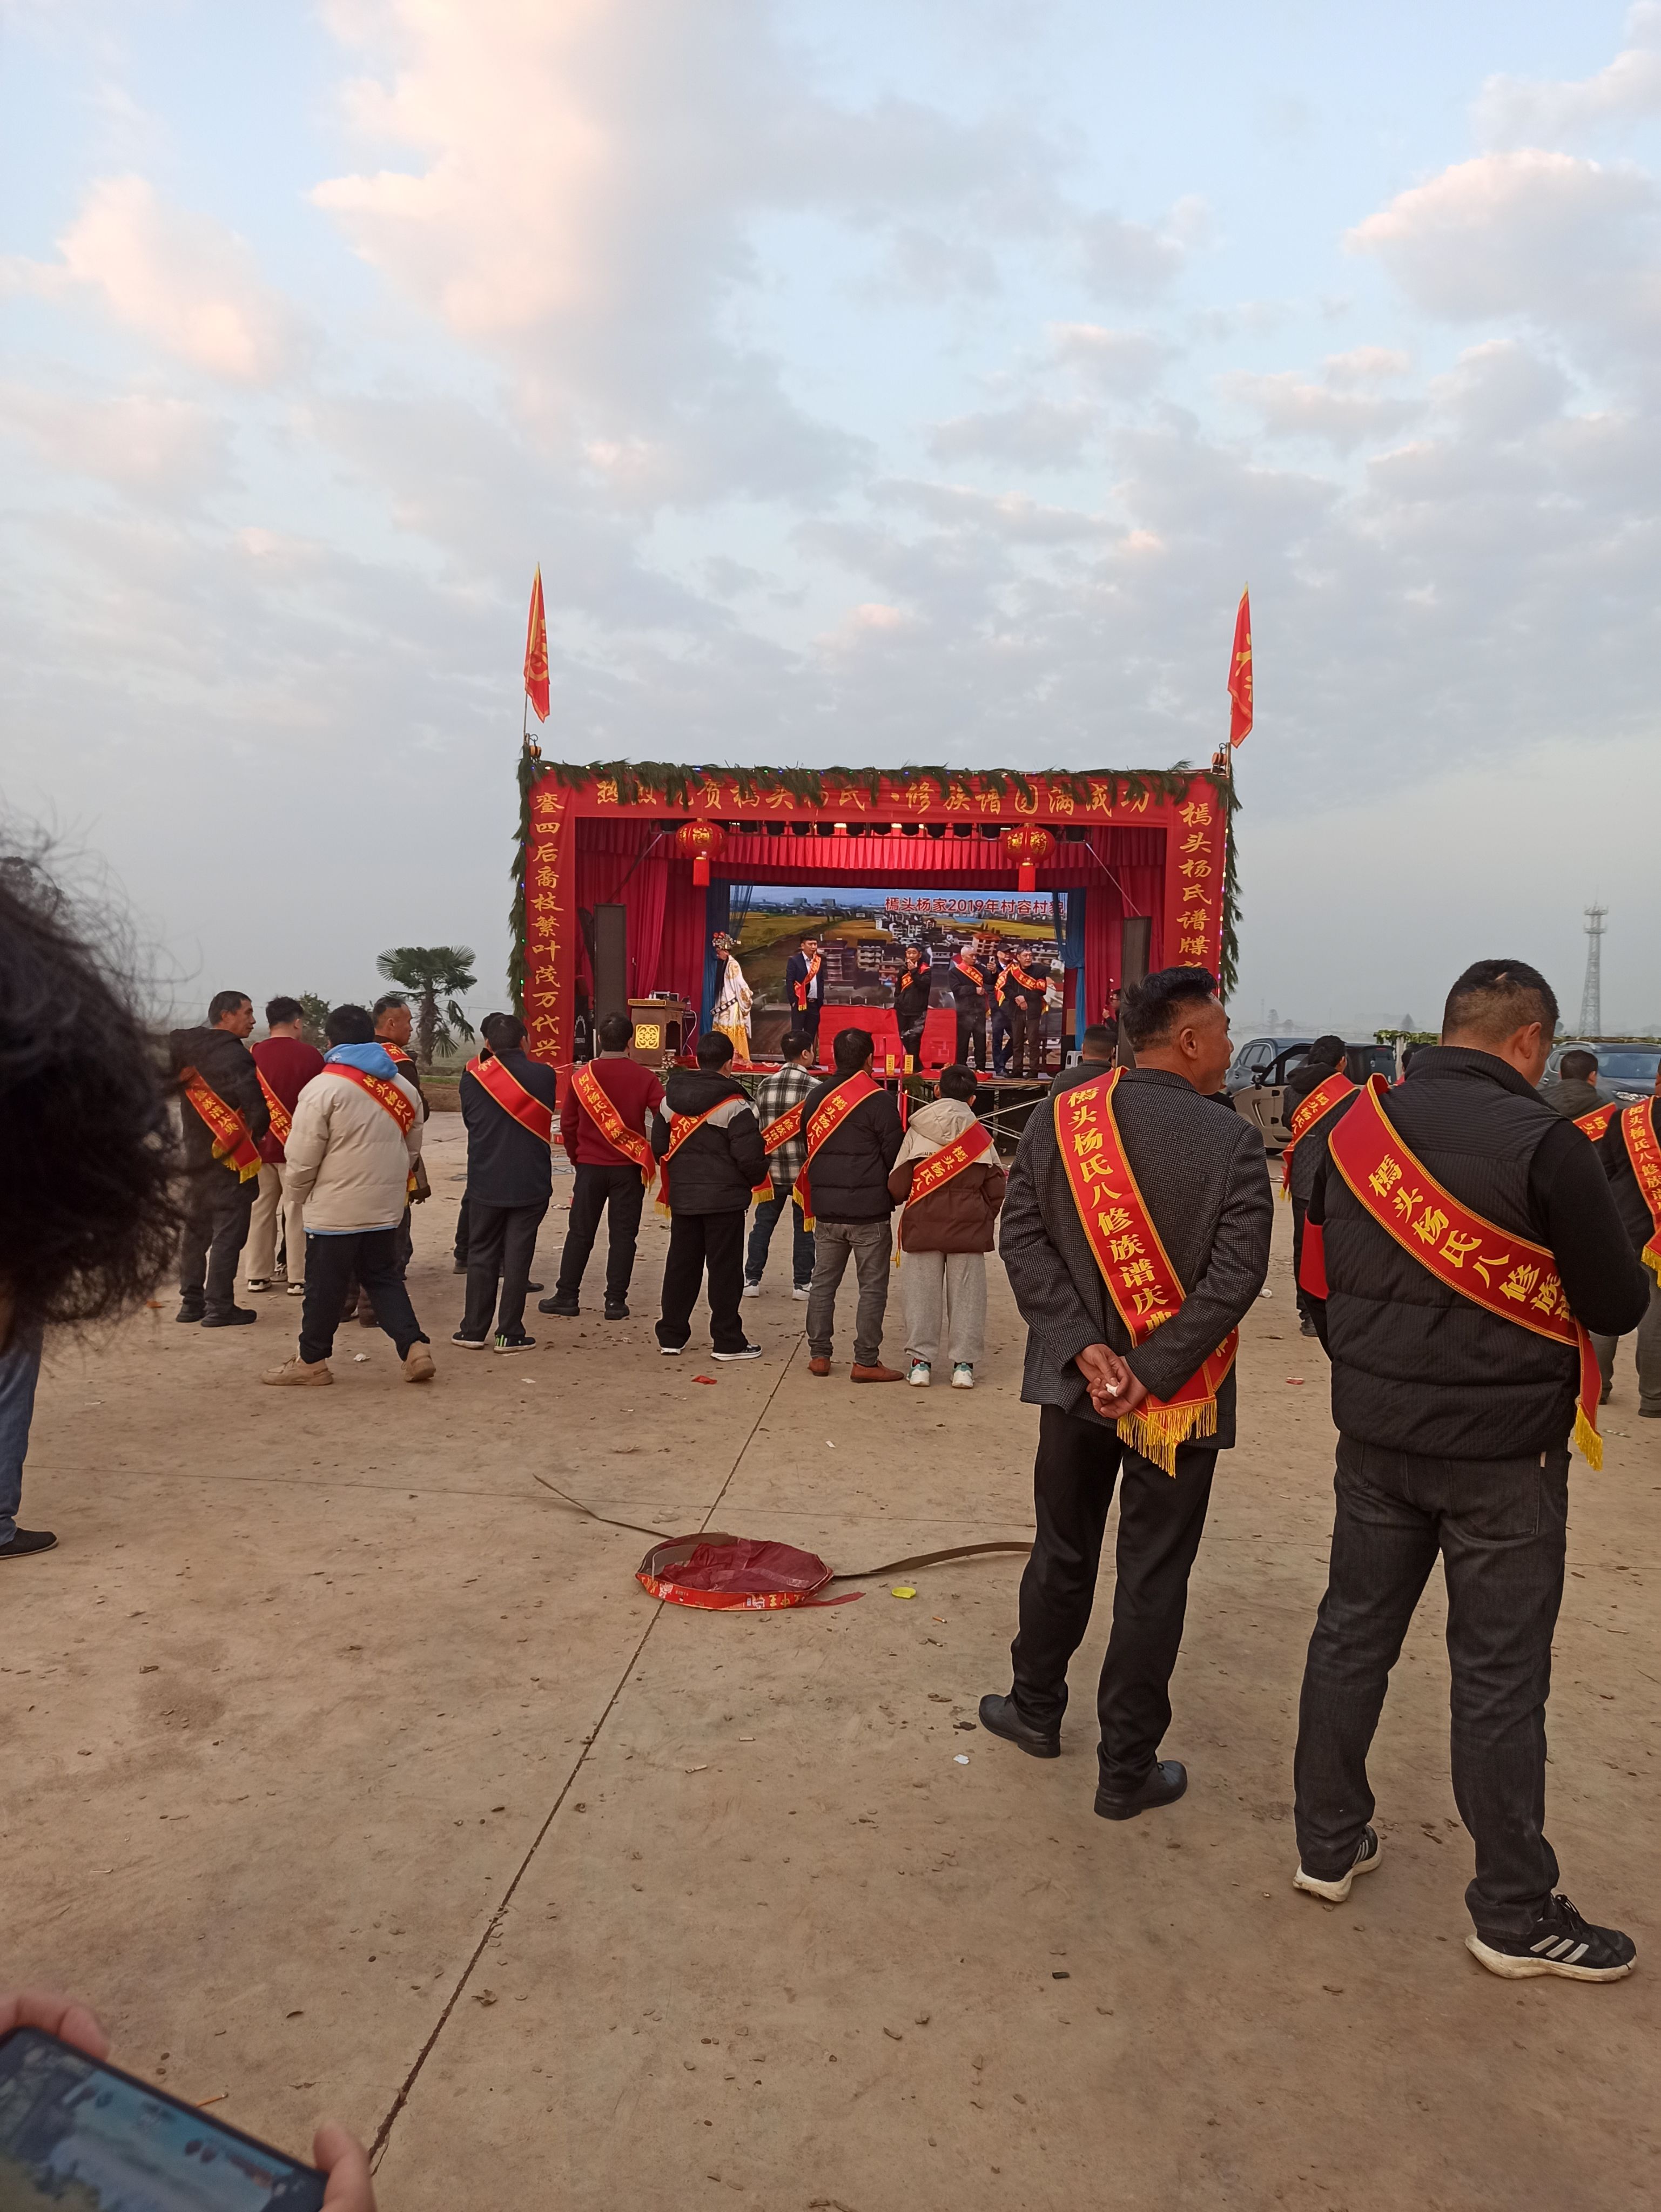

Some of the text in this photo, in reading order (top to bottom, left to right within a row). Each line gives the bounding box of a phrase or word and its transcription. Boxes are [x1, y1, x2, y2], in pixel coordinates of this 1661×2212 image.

[530, 792, 565, 1074] 銮四后裔枝繁叶茂万代兴
